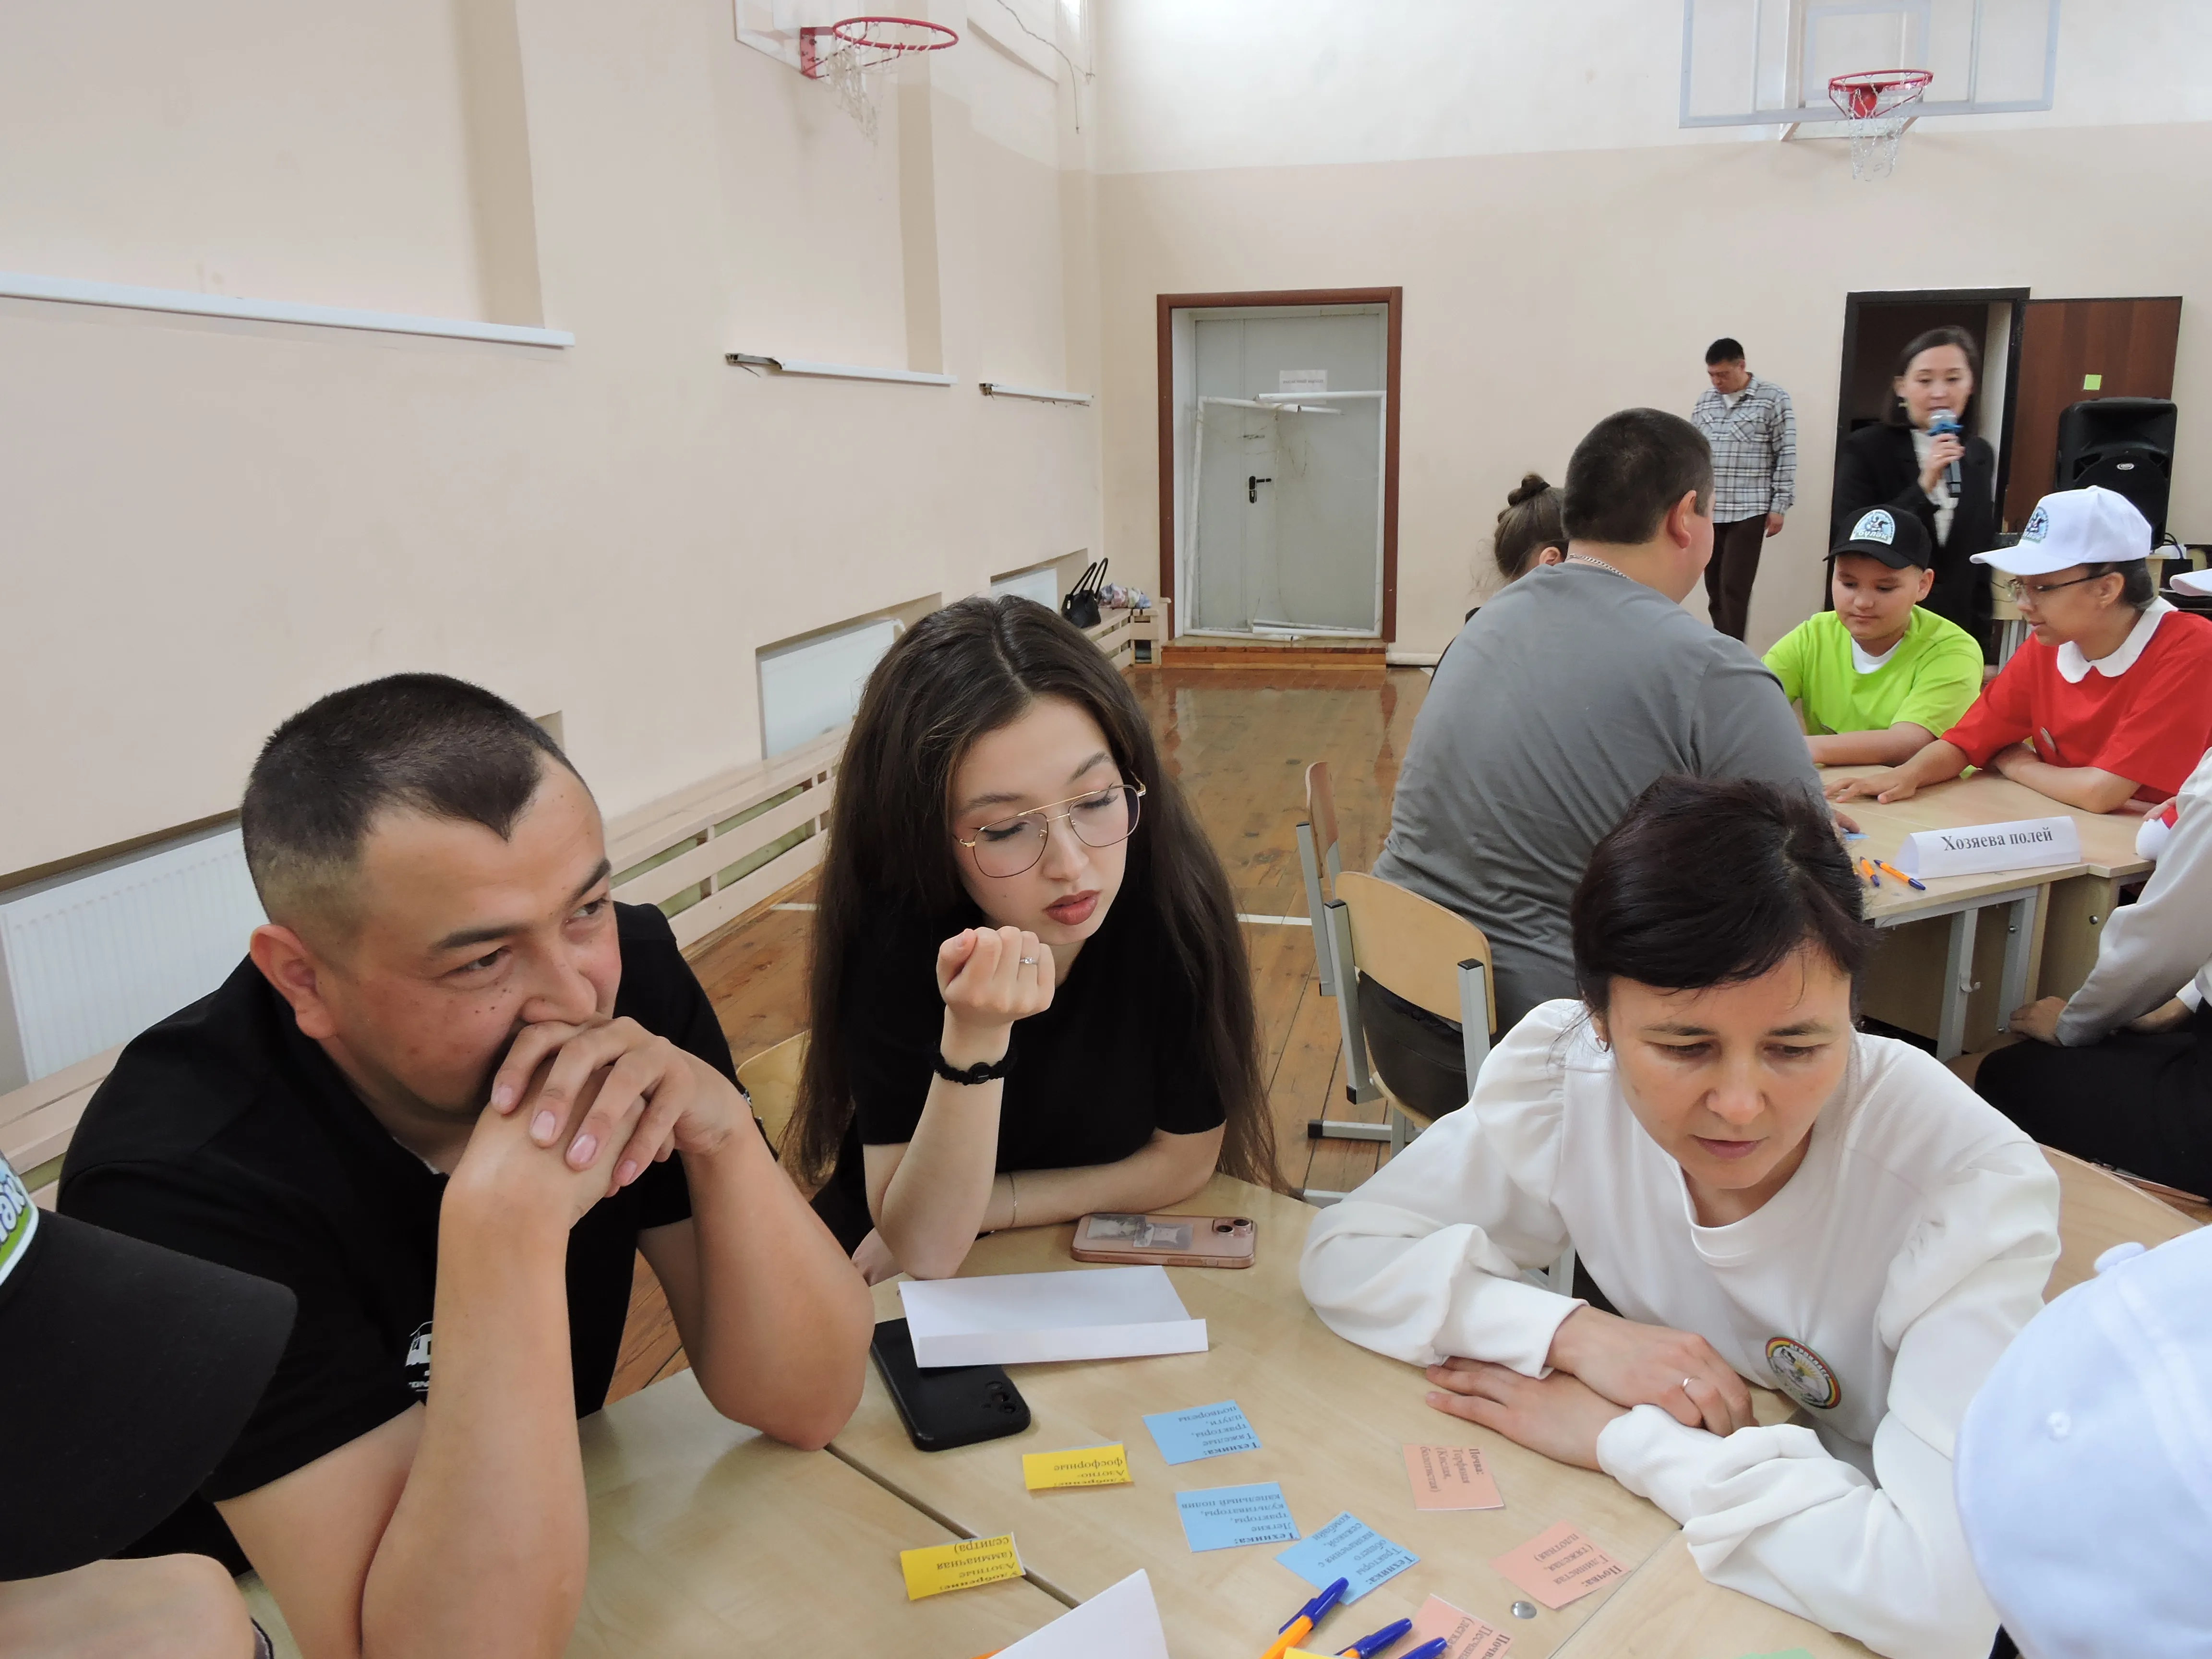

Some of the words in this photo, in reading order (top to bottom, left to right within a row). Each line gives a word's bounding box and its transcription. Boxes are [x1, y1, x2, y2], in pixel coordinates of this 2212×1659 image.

[1940, 834, 2006, 851] Хозяева
[2009, 827, 2053, 845] полей
[1178, 1406, 1237, 1422] почворезы
[1191, 1423, 1247, 1438] тракторы,
[1202, 1432, 1255, 1446] Тяжелые
[1203, 1442, 1261, 1455] Техника:
[1054, 1457, 1123, 1471] фосфорные
[1419, 1446, 1442, 1492] болотистая)
[1452, 1448, 1470, 1483] Торфяная
[1468, 1448, 1484, 1475] Почва:
[1181, 1500, 1215, 1509] полив
[1219, 1493, 1281, 1505] капельный
[1251, 1522, 1291, 1532] Легкие
[1311, 1514, 1351, 1541] комбайн
[954, 1537, 1010, 1555] селитра)
[1235, 1532, 1297, 1544] Техника:
[1324, 1531, 1375, 1564] назначения
[1533, 1533, 1580, 1563] плотная)
[937, 1550, 1013, 1570] (аммиачная
[1353, 1539, 1387, 1561] общего
[959, 1562, 1015, 1578] Азотные
[1356, 1547, 1402, 1575] Тракторы
[1366, 1555, 1416, 1585] Техника:
[1552, 1553, 1609, 1585] Глинистая
[1581, 1564, 1623, 1587] Почва:
